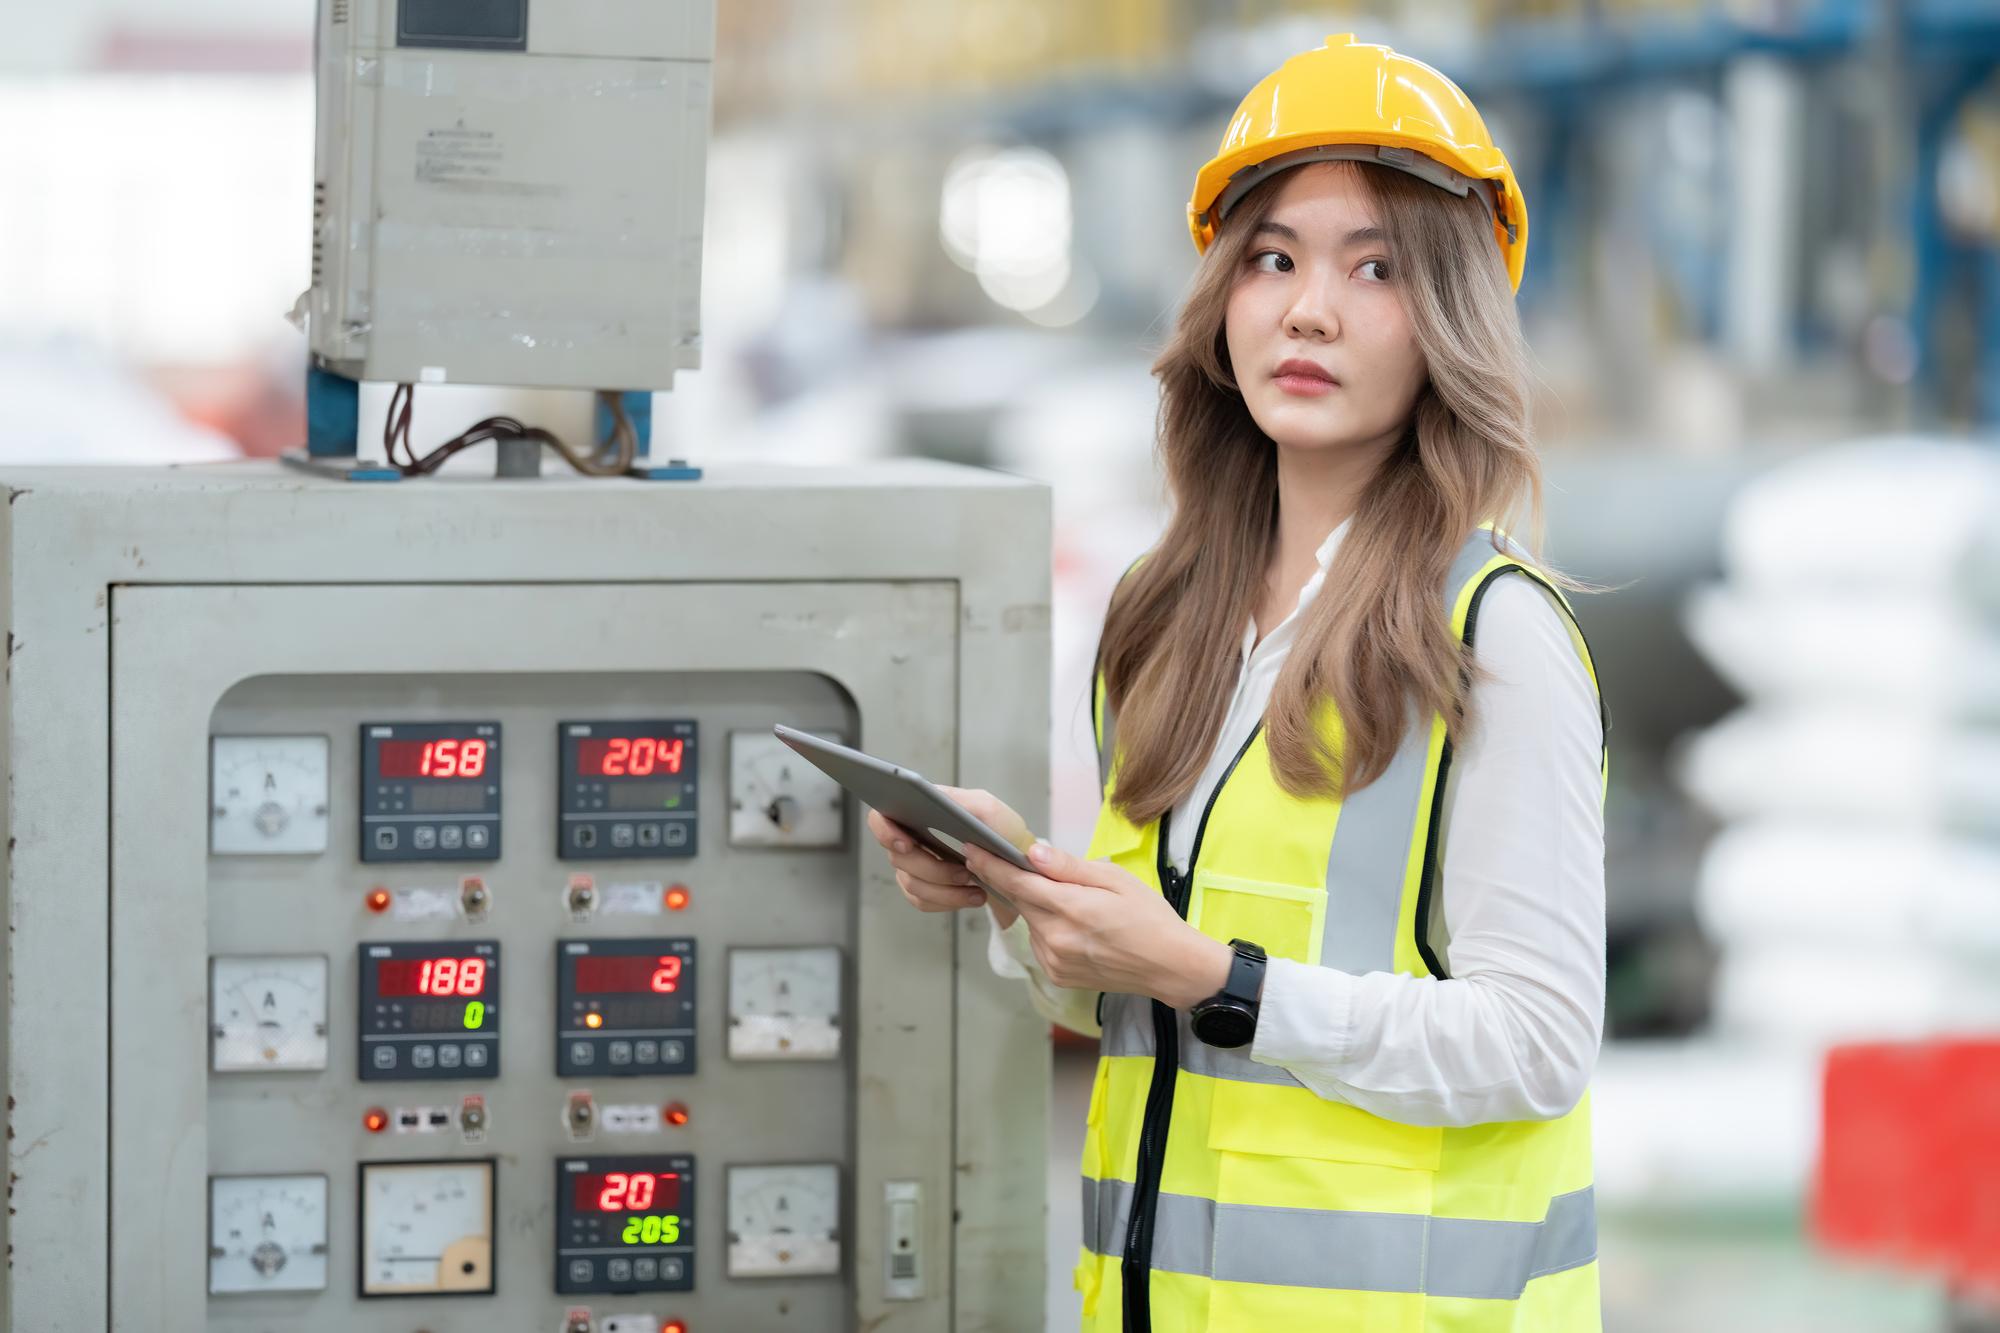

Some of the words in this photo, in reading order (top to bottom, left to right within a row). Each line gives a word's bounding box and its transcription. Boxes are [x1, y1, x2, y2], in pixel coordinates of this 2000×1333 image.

[420, 739, 487, 778] 158
[602, 737, 684, 776] 204
[263, 772, 277, 791] A
[419, 958, 486, 996] 188
[651, 956, 682, 993] 2
[262, 989, 276, 1008] A
[463, 1001, 485, 1029] 0
[599, 1172, 679, 1211] 20
[261, 1210, 276, 1230] A
[622, 1215, 680, 1244] 205
